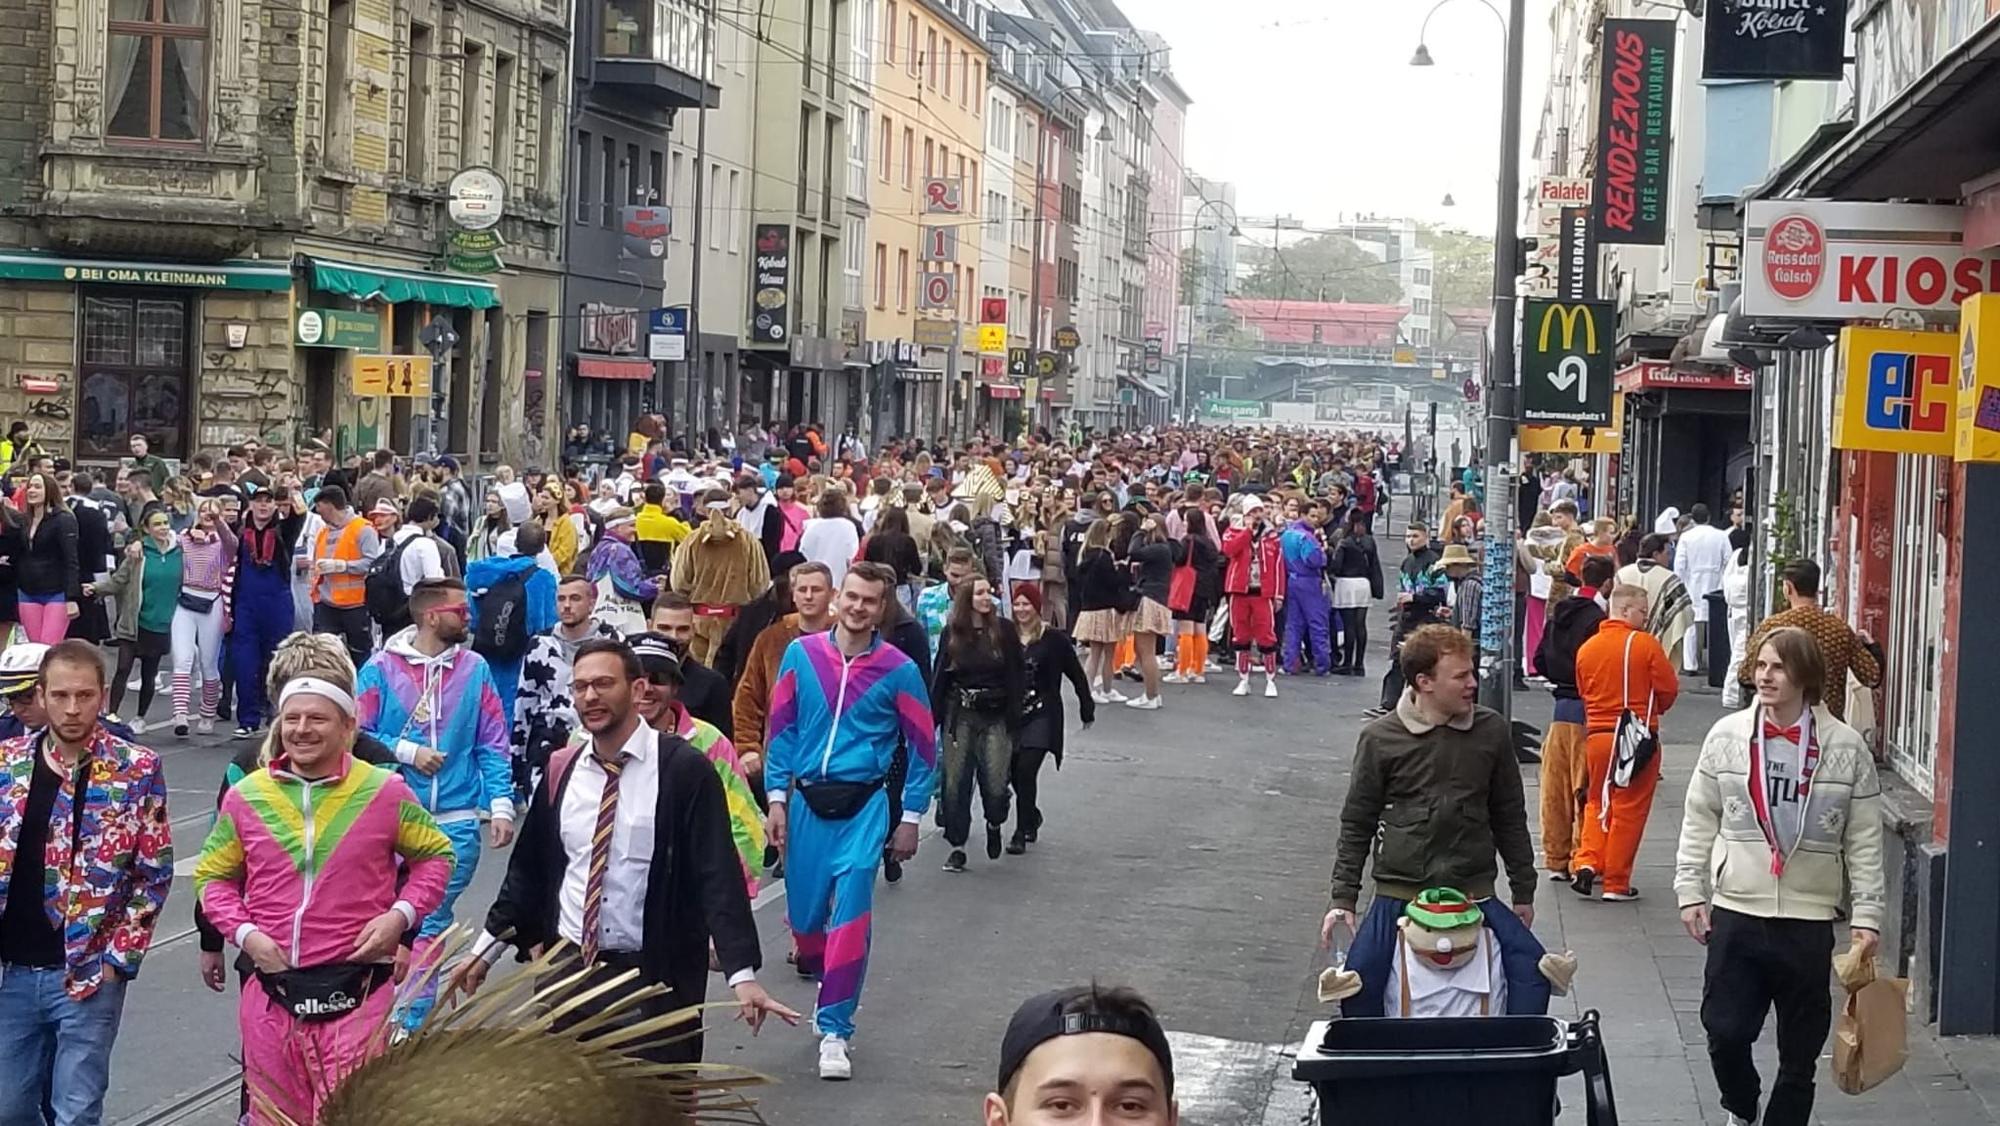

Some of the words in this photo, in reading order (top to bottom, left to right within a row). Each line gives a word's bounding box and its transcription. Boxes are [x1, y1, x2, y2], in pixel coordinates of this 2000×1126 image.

[1735, 10, 1809, 39] Kölsch
[1647, 47, 1666, 136] RESTAURANT
[1606, 30, 1644, 232] RENDEZVOUS
[1644, 148, 1660, 174] BAR
[1541, 181, 1589, 200] Falafel
[1642, 185, 1657, 221] CAFÉ
[81, 268, 103, 280] BEI
[107, 269, 140, 281] OMA
[144, 271, 227, 285] KLEINMANN
[1838, 255, 2000, 305] KIOS
[1211, 404, 1259, 417] Ausgang
[294, 998, 356, 1014] ellesse
